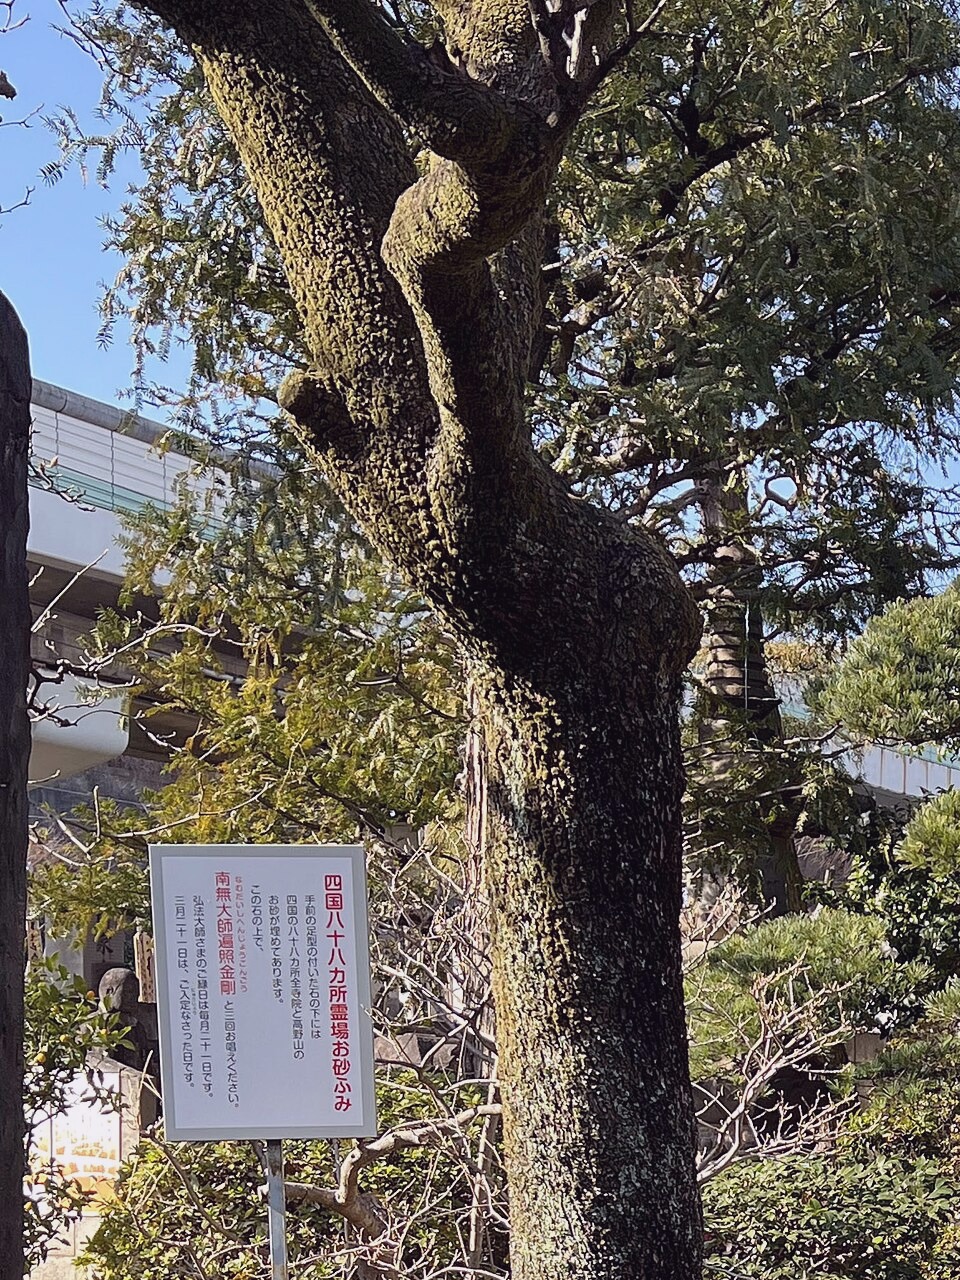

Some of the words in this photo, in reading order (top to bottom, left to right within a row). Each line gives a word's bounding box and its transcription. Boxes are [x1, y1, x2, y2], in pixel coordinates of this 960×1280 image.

[174, 895, 195, 1088] 三月二十一日は、ご入定なさった日です。
[193, 895, 213, 1097] 弘法大師さまのご縁日は毎月二十一日です。
[251, 885, 264, 952] この石の上で、
[269, 895, 284, 1003] お砂が埋めてあります。
[287, 895, 304, 1060] 四国の八十八カ所全寺院と高野山の
[305, 895, 321, 1039] 手前の足型の付いた石の下には
[325, 874, 352, 1112] 四国八十八カ所霊場お砂ふみ
